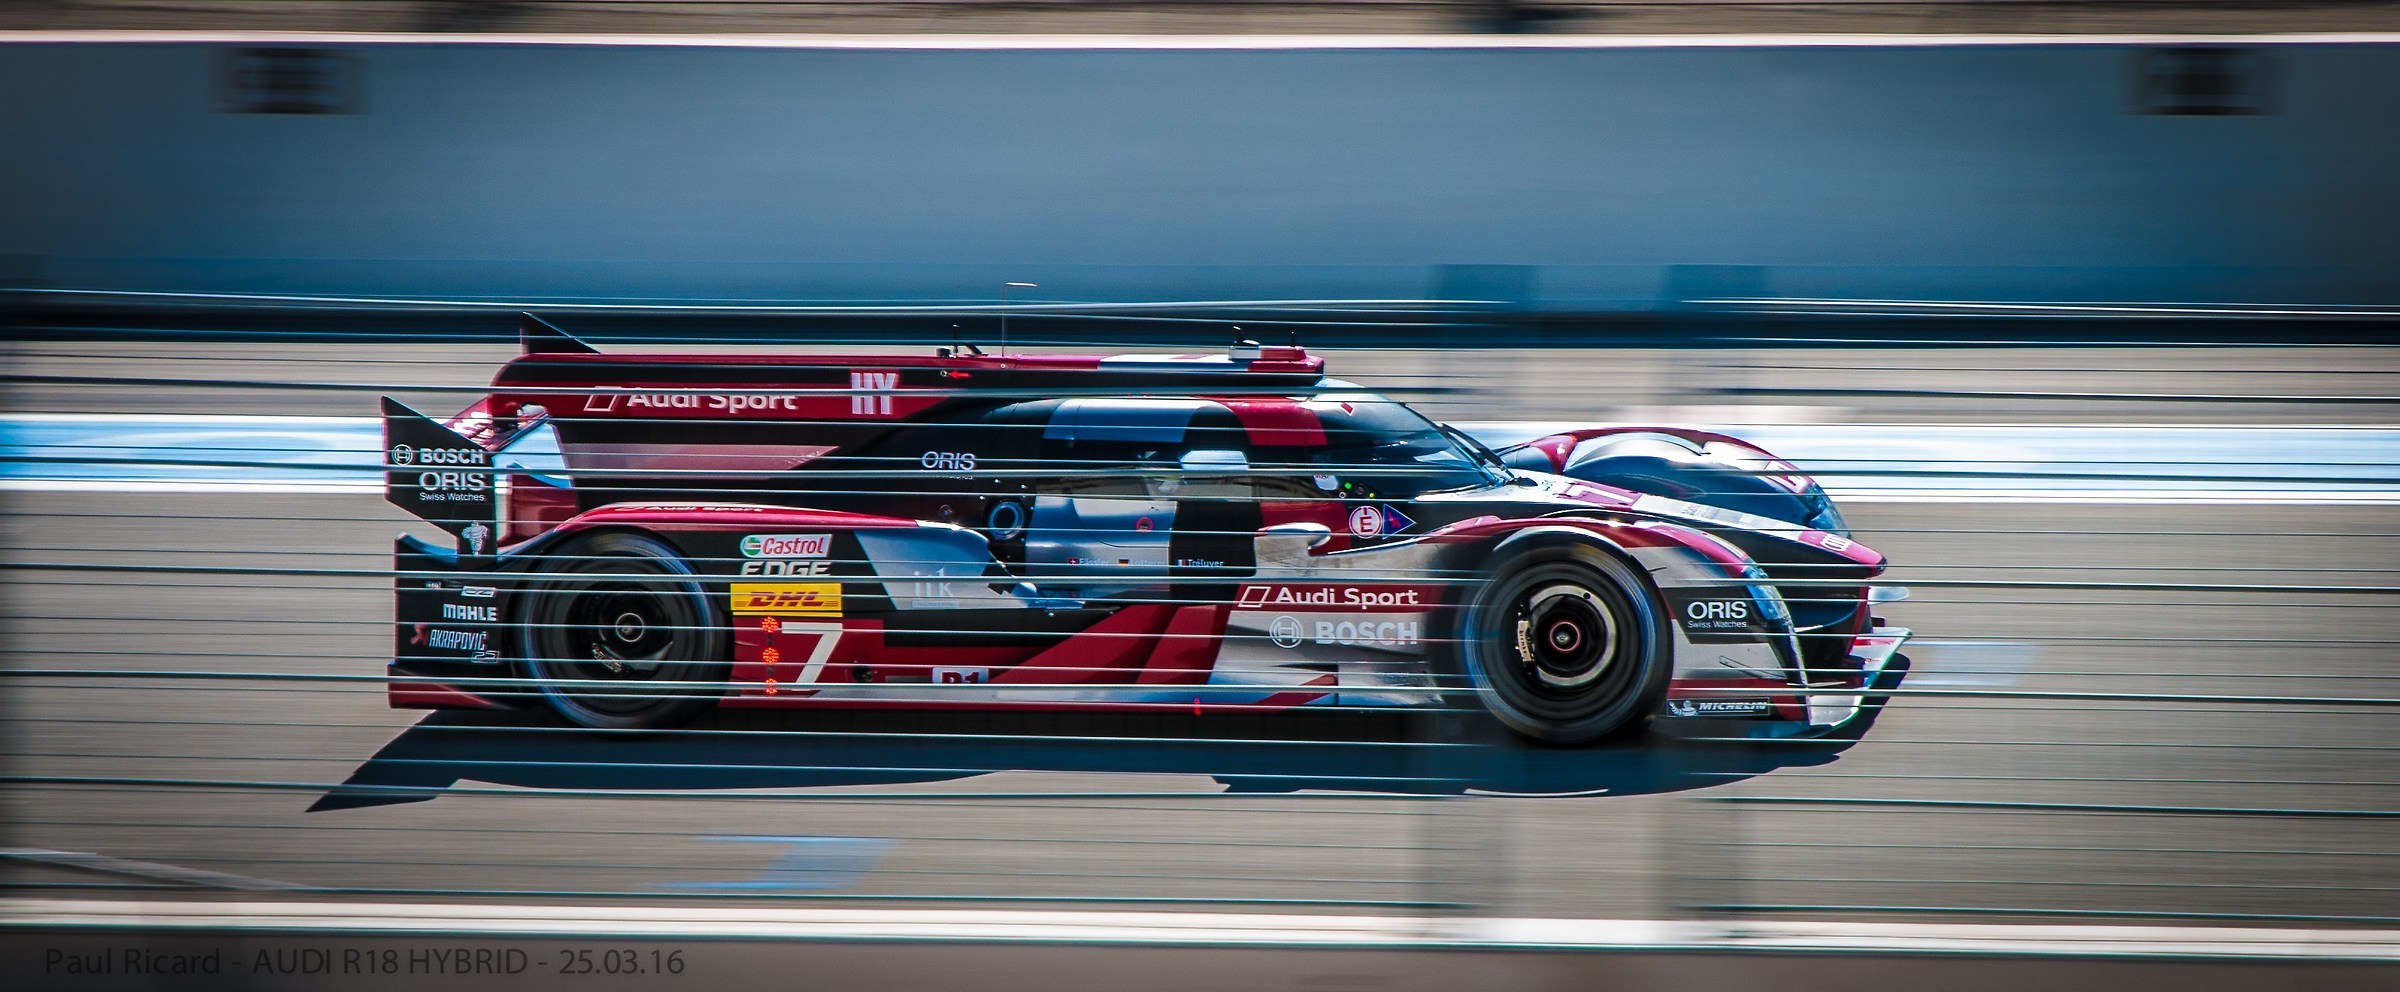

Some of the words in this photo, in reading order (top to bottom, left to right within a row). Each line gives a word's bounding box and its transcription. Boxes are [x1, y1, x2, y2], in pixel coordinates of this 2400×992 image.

[850, 372, 897, 415] HY
[420, 447, 485, 464] BOSCH
[920, 450, 976, 472] ORIS
[419, 471, 486, 491] ORIS
[419, 492, 446, 501] Swiss
[447, 492, 486, 501] Watches
[762, 537, 825, 555] Castrol
[741, 561, 833, 577] EDGE
[747, 591, 824, 607] DHL
[1274, 586, 1336, 605] Audi
[1344, 587, 1419, 610] Sport
[443, 603, 497, 621] MAHLE
[1687, 601, 1747, 619] ORIS
[1315, 621, 1418, 647] BOSCH
[1687, 621, 1711, 629] Swiss
[1713, 621, 1747, 629] Watches
[781, 621, 843, 691] 7
[1700, 702, 1767, 711] MICHELIN
